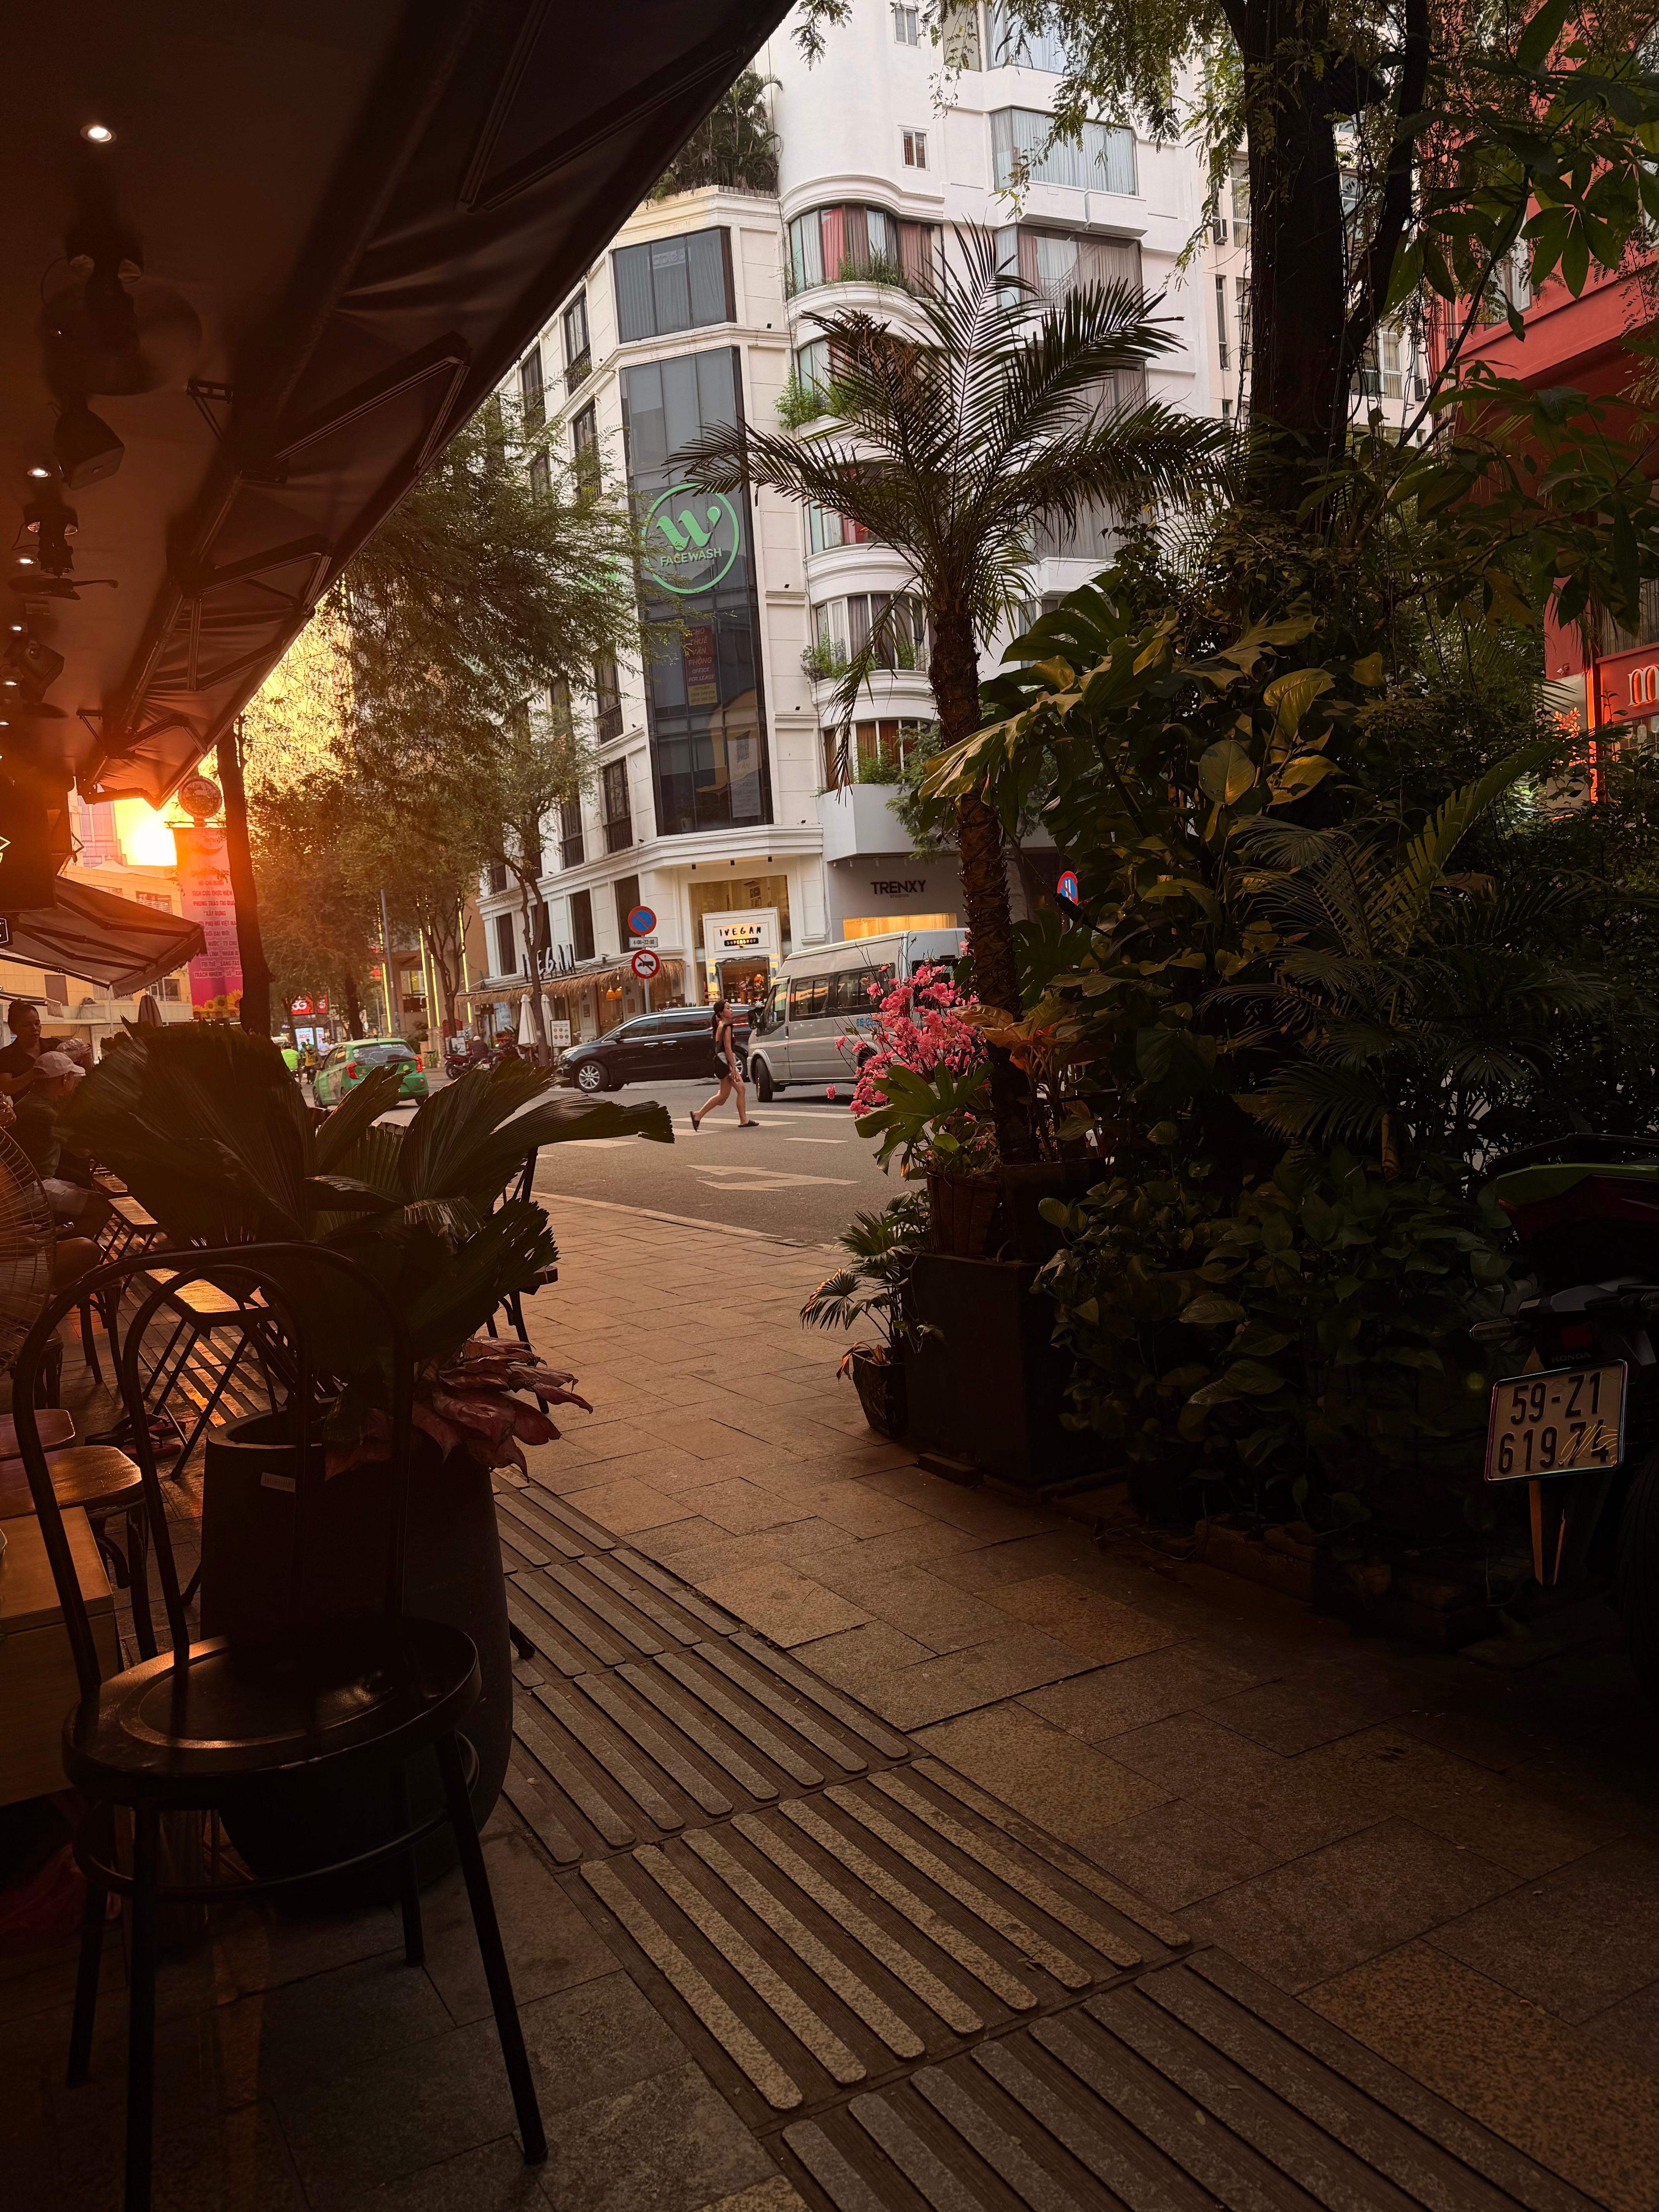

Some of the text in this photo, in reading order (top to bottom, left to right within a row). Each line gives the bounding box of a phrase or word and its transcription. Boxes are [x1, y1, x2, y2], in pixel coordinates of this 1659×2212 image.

[660, 547, 722, 567] FACEWASH
[690, 635, 708, 645] THUÊ
[692, 646, 706, 655] VĂN
[688, 656, 712, 666] PHÒNG
[871, 880, 926, 894] TRENXY
[720, 926, 761, 936] IVEGAN
[1551, 1352, 1592, 1363] HONDA
[1511, 1372, 1601, 1425] 59-Z1
